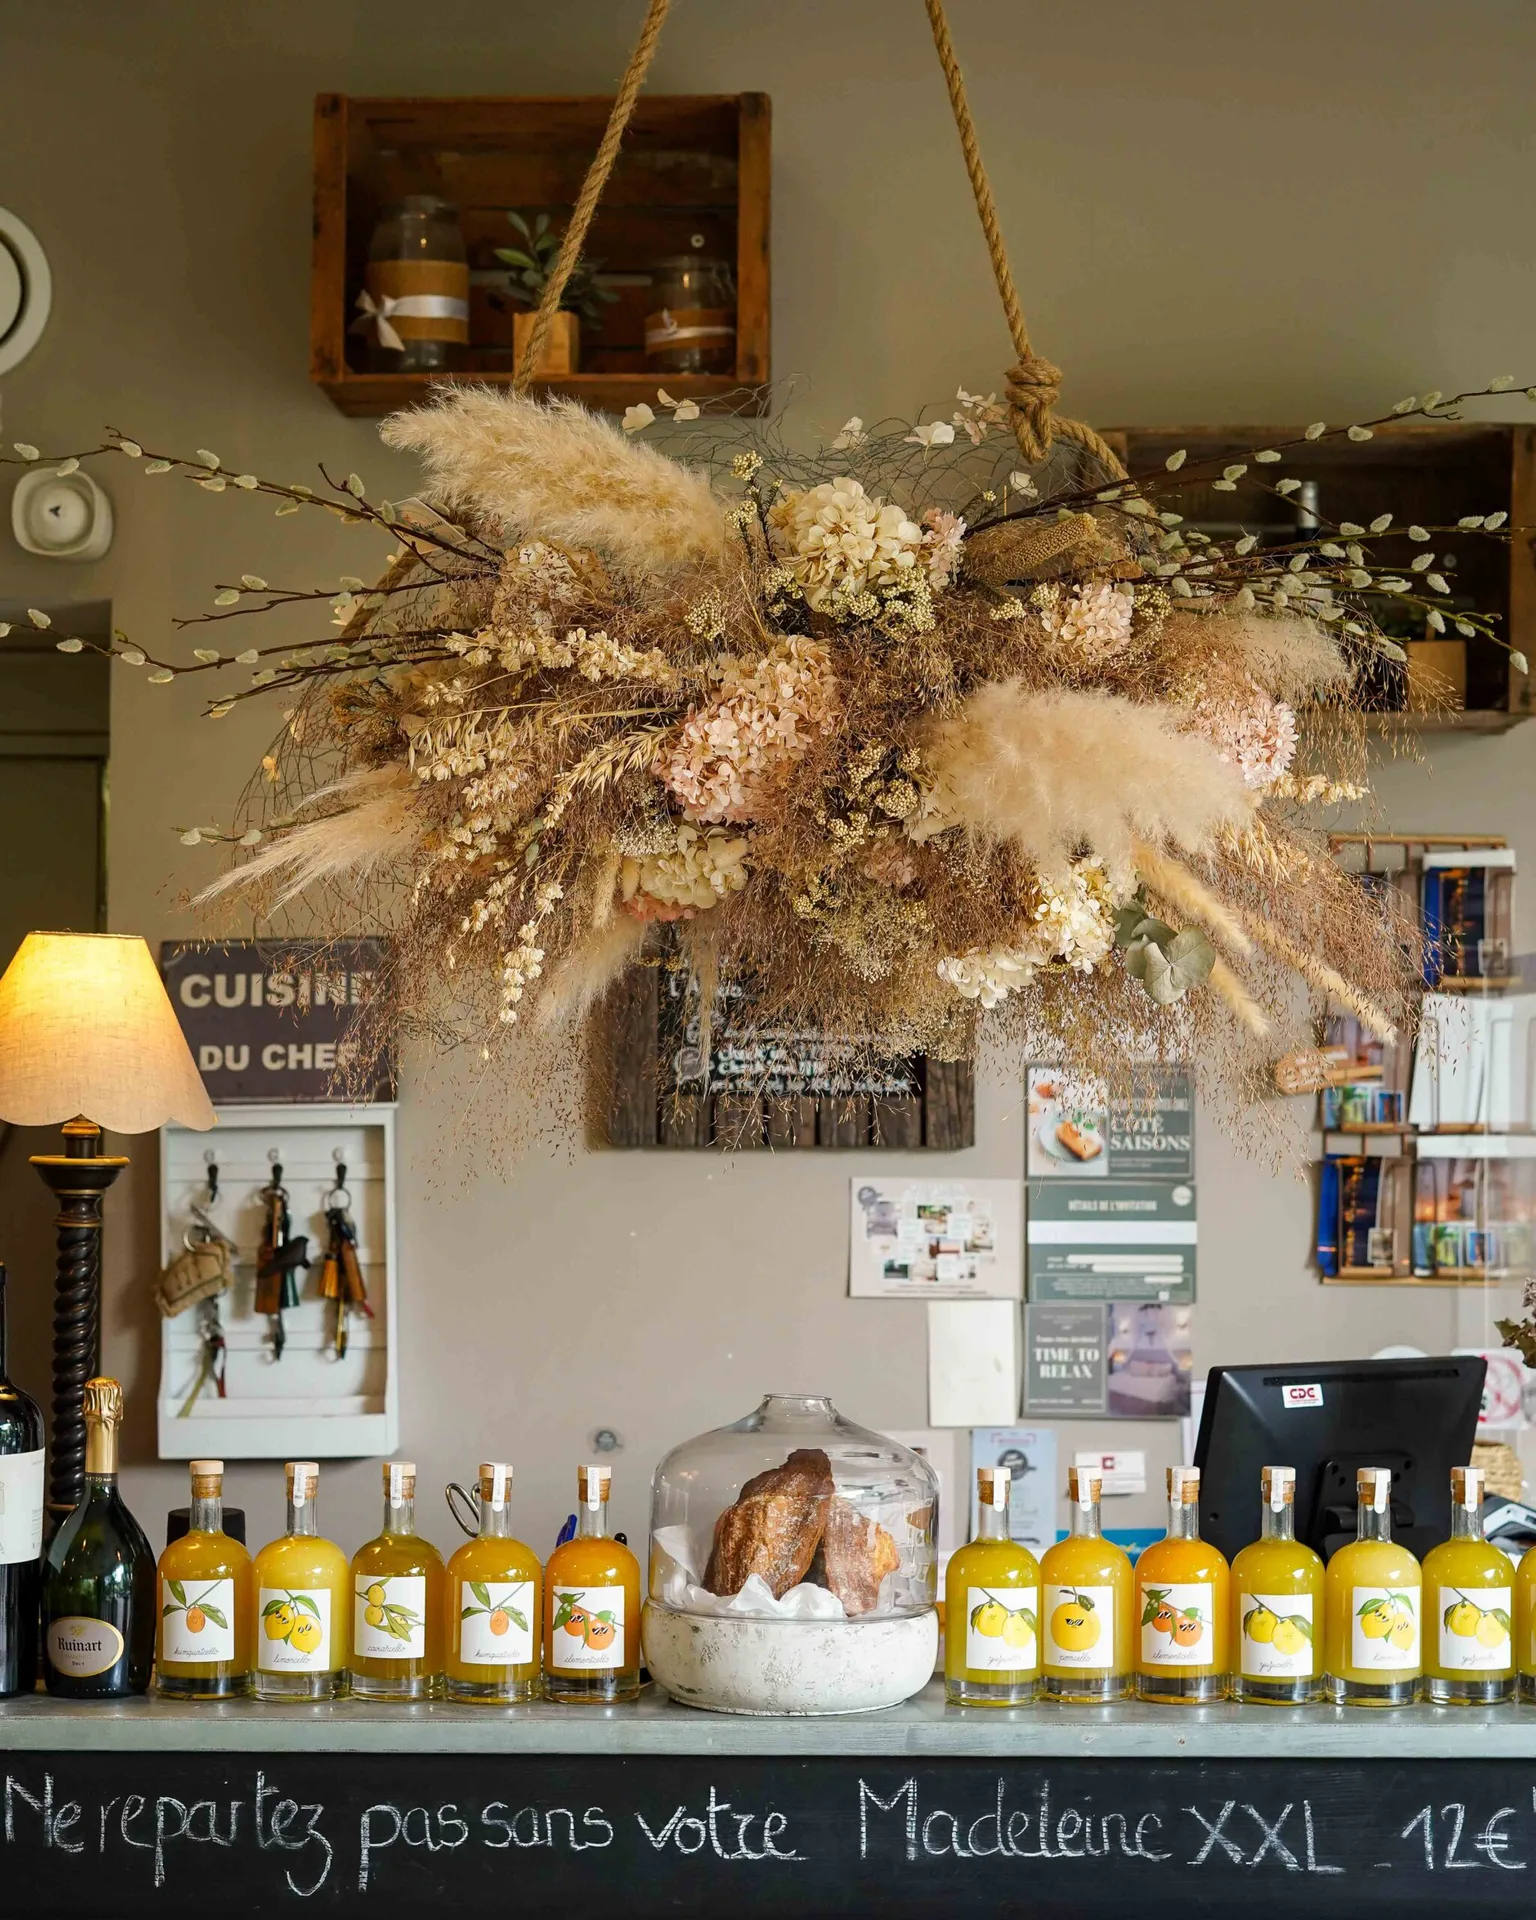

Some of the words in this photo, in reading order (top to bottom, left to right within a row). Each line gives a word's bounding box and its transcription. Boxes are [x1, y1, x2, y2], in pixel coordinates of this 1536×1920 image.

[199, 1045, 250, 1071] DU
[1110, 1135, 1190, 1151] SAISONS
[1035, 1348, 1073, 1362] TIME
[1076, 1348, 1100, 1362] TO
[1039, 1364, 1093, 1379] RELAX
[1290, 1387, 1315, 1399] CDC
[58, 1637, 102, 1651] Ruinart
[5, 1772, 84, 1853] Ne
[100, 1771, 333, 1896] repartez
[359, 1805, 468, 1890] pas
[482, 1802, 613, 1850] sans
[638, 1786, 806, 1860] votre
[859, 1778, 1172, 1860] Madeleine
[1182, 1800, 1343, 1873] XXL
[1401, 1804, 1527, 1869] 12€
